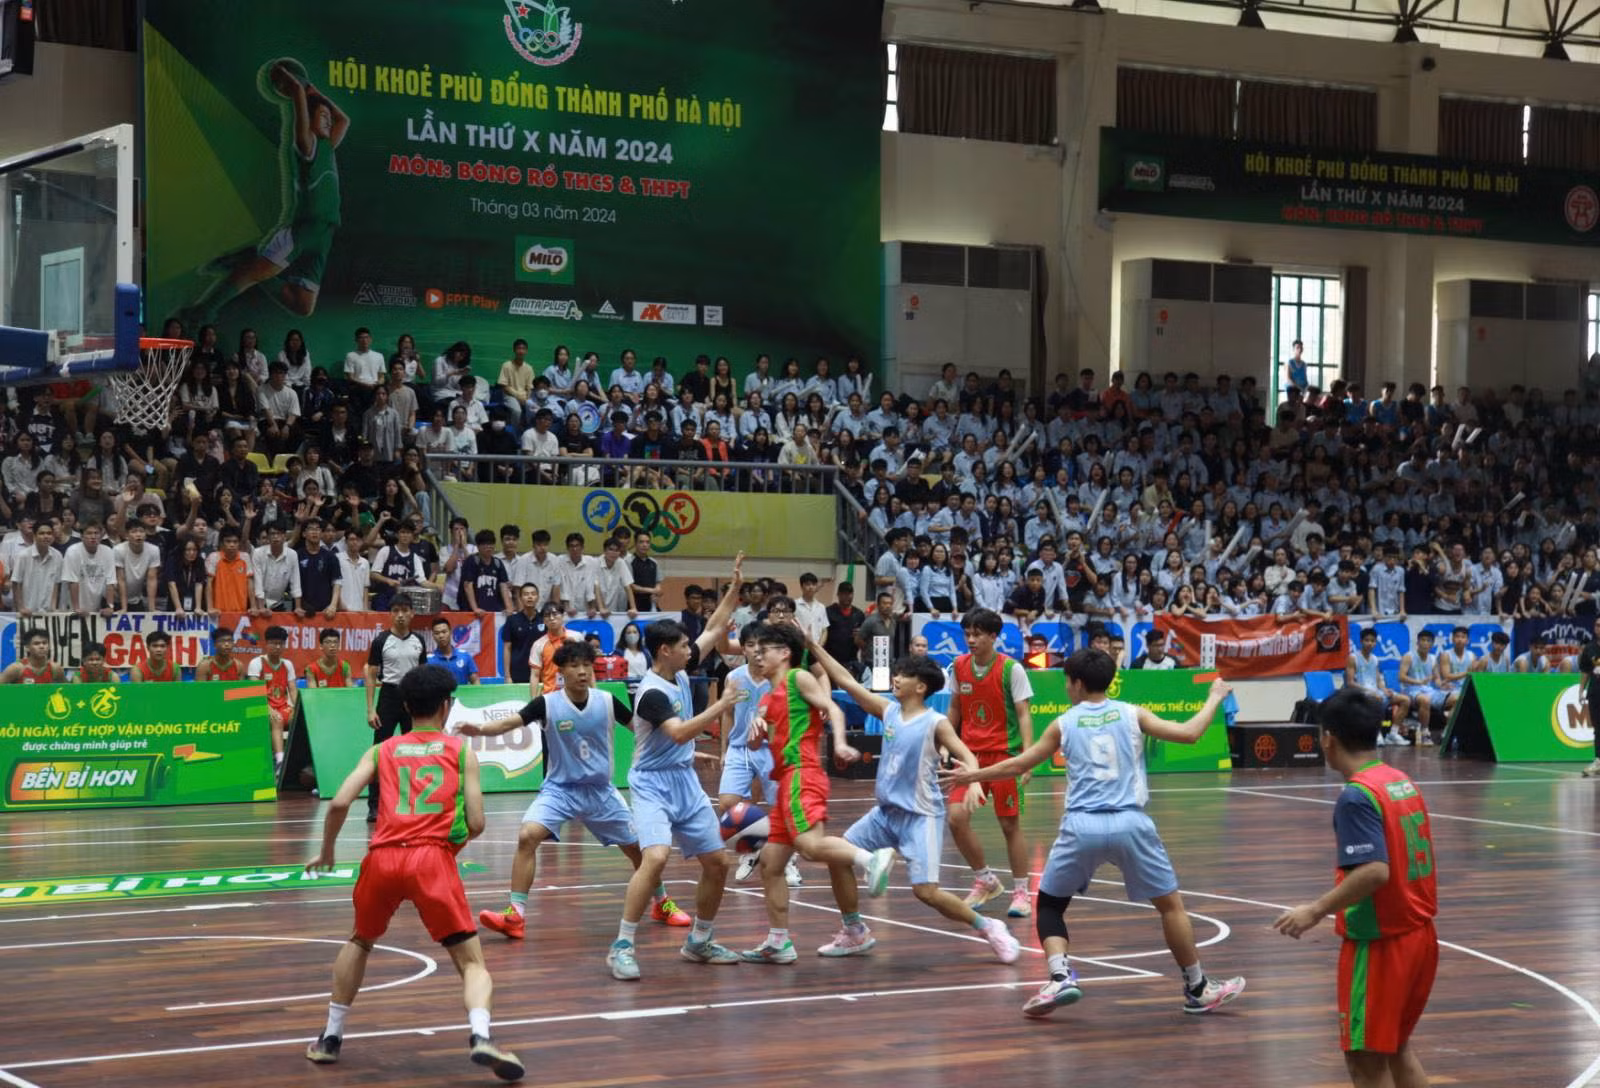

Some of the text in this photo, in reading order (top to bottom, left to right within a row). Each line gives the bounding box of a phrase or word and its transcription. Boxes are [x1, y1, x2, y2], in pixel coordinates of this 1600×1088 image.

[328, 57, 741, 132] HỘI KHOẺ PHÙ ĐỔNG THÀNH PHỐ HÀ NỘI
[406, 108, 674, 165] LẦN THỨ X NĂM 2024
[389, 155, 691, 199] MÔN: BÓNG RỔ THCS & THPT
[470, 197, 617, 223] Tháng 03 năm 2024
[1371, 192, 1383, 206] X
[1428, 196, 1466, 212] 2024
[529, 253, 562, 266] MILO
[446, 294, 500, 312] FPT Play
[103, 634, 198, 667] GAH
[976, 705, 985, 724] 4
[63, 723, 87, 737] KẾT
[88, 724, 115, 740] HỢP
[118, 722, 143, 740] VẬN
[145, 721, 183, 740] ĐỘNG
[185, 720, 209, 735] THỂ
[210, 721, 242, 735] CHẤT
[22, 741, 47, 752] được
[49, 740, 82, 752] chứng
[82, 739, 108, 750] minh
[110, 739, 133, 752] giúp
[1090, 735, 1119, 780] 9
[21, 764, 138, 790] BỀN BỈ HƠN
[396, 765, 444, 816] 12
